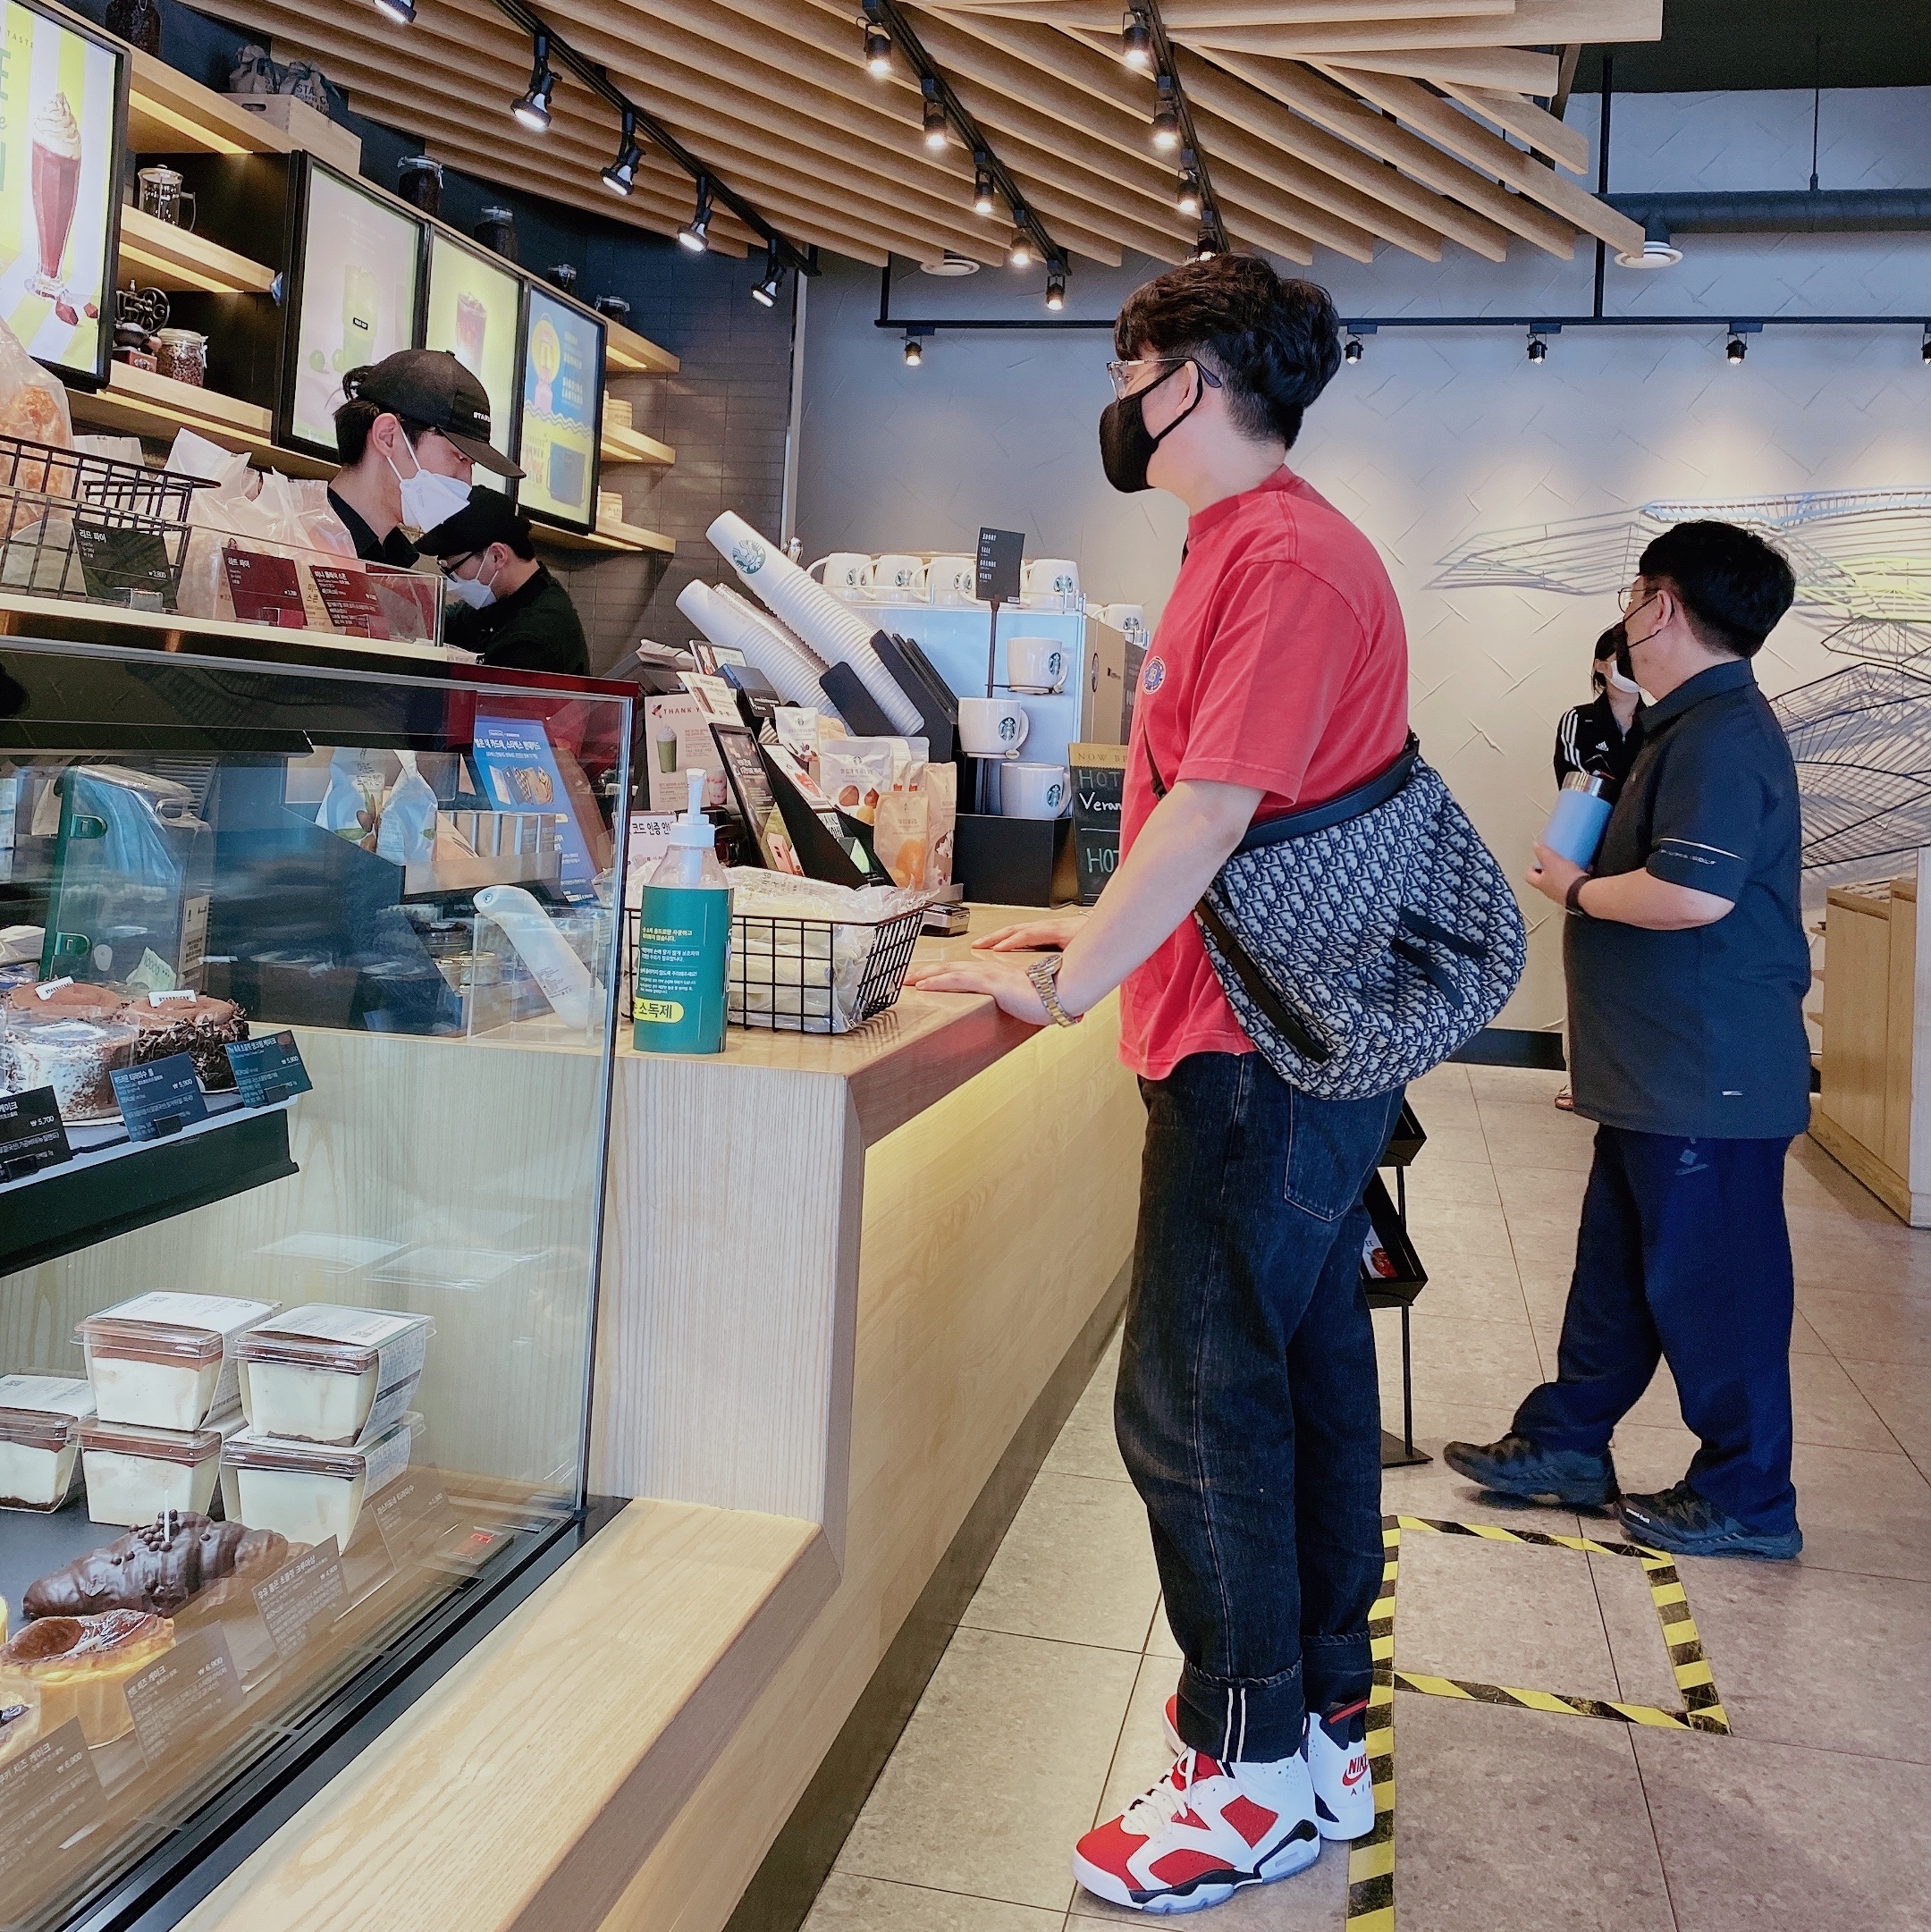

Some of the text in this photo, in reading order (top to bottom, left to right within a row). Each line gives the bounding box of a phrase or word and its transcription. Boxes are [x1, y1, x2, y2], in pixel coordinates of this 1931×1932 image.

[79, 529, 106, 544] 리프 파이
[307, 595, 319, 603] 스콘
[663, 706, 692, 715] THANK
[1078, 752, 1107, 762] NOW
[1078, 769, 1121, 789] HOT
[632, 823, 646, 834] 코드
[646, 822, 661, 835] 인증
[639, 1002, 672, 1019] 소독제
[38, 1115, 55, 1126] 5,700
[257, 1587, 268, 1599] 우유
[148, 1665, 167, 1682] 케이크
[13, 1759, 29, 1775] 치즈
[30, 1742, 52, 1763] 케이크
